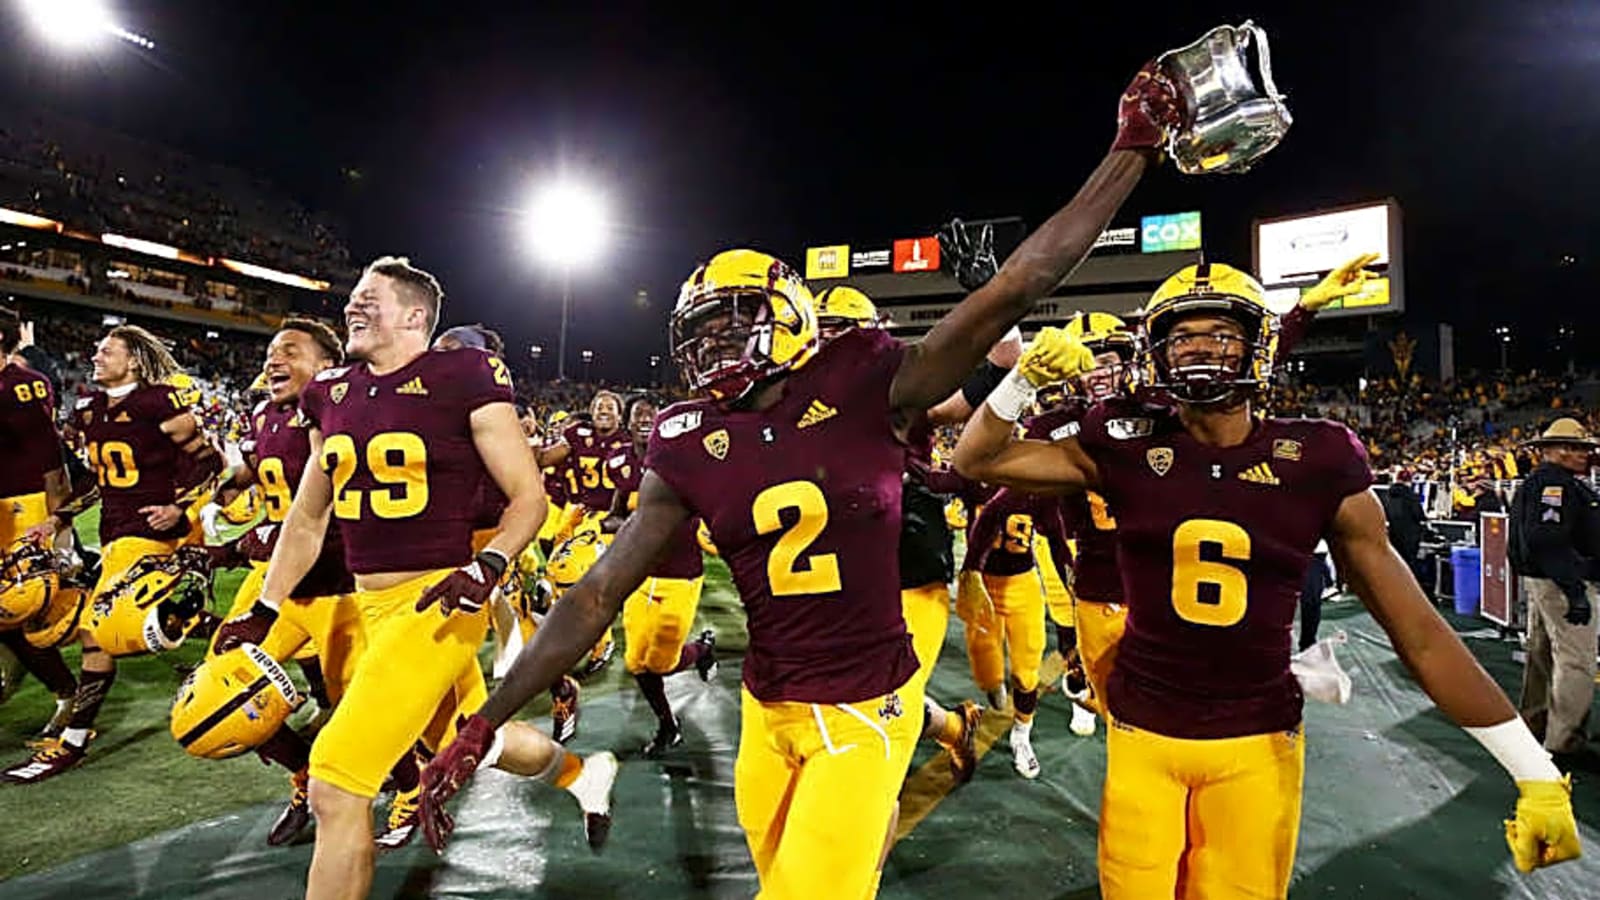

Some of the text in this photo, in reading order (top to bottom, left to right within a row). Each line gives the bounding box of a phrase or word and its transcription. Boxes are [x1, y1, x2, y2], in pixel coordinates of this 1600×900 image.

[1142, 223, 1199, 244] COX
[487, 357, 511, 386] 2
[88, 441, 140, 488] 10
[321, 432, 429, 519] 29
[752, 480, 842, 596] 2
[1172, 518, 1252, 627] 6
[253, 652, 294, 697] Riddell
